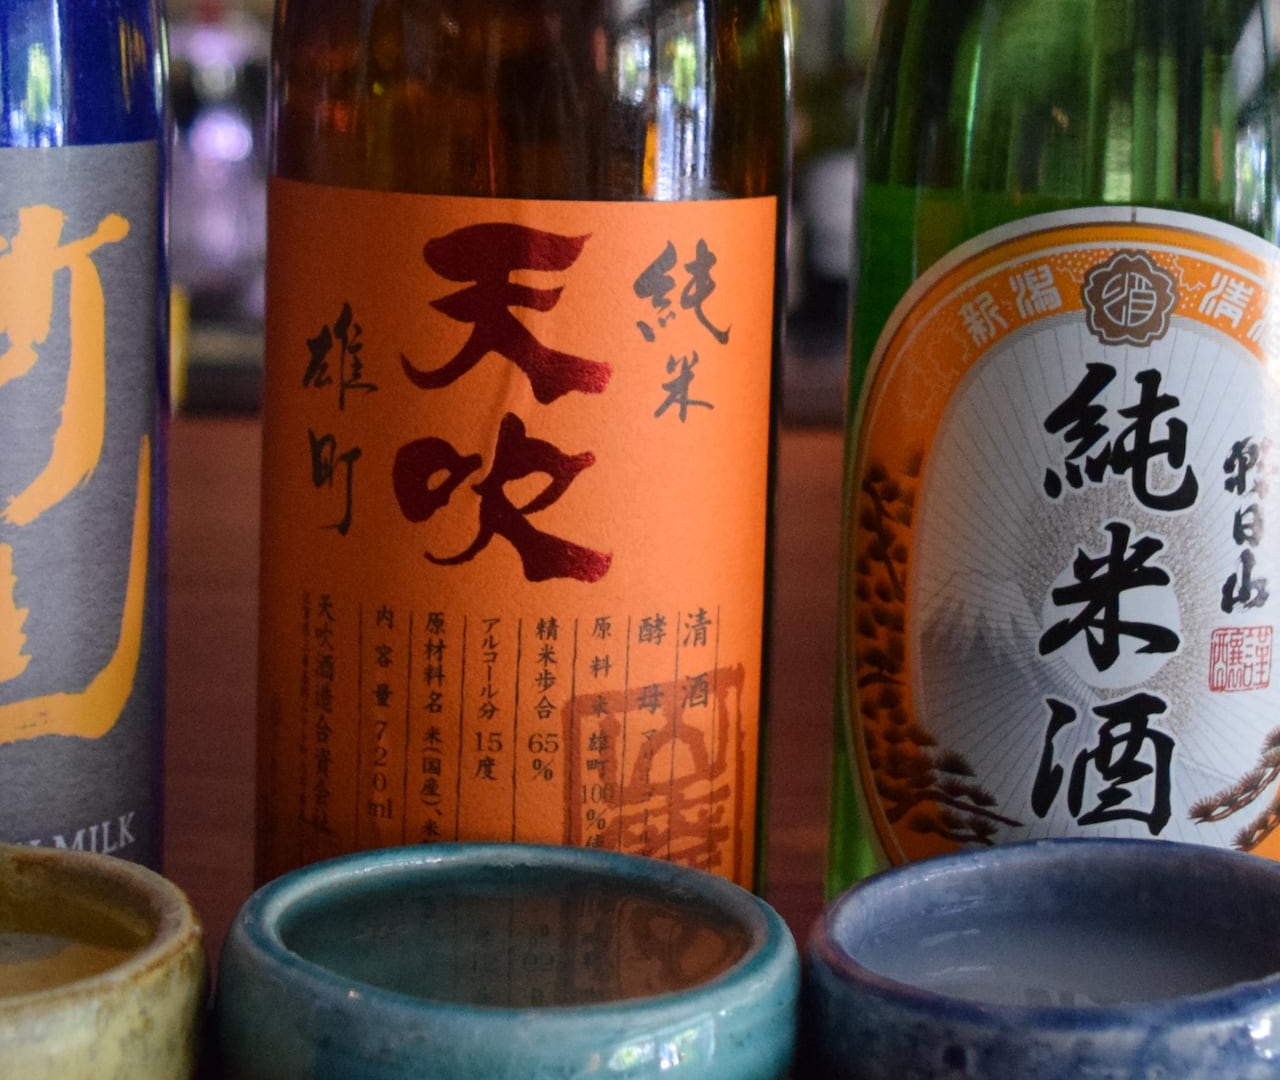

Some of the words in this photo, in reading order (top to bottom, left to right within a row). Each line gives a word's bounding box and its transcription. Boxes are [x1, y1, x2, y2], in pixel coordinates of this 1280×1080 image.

[632, 239, 732, 423] 純米
[301, 301, 379, 537] 雄町
[392, 222, 613, 584] 天吹
[1031, 362, 1199, 836] 純米酒
[372, 604, 395, 708] 内容量
[423, 612, 447, 714] 原材料名
[478, 617, 501, 720] アルコール分
[534, 617, 560, 720] 精米歩合
[636, 613, 667, 714] 酵母
[679, 607, 712, 709] 清酒
[473, 730, 503, 782] 15度
[528, 731, 559, 781] 65%
